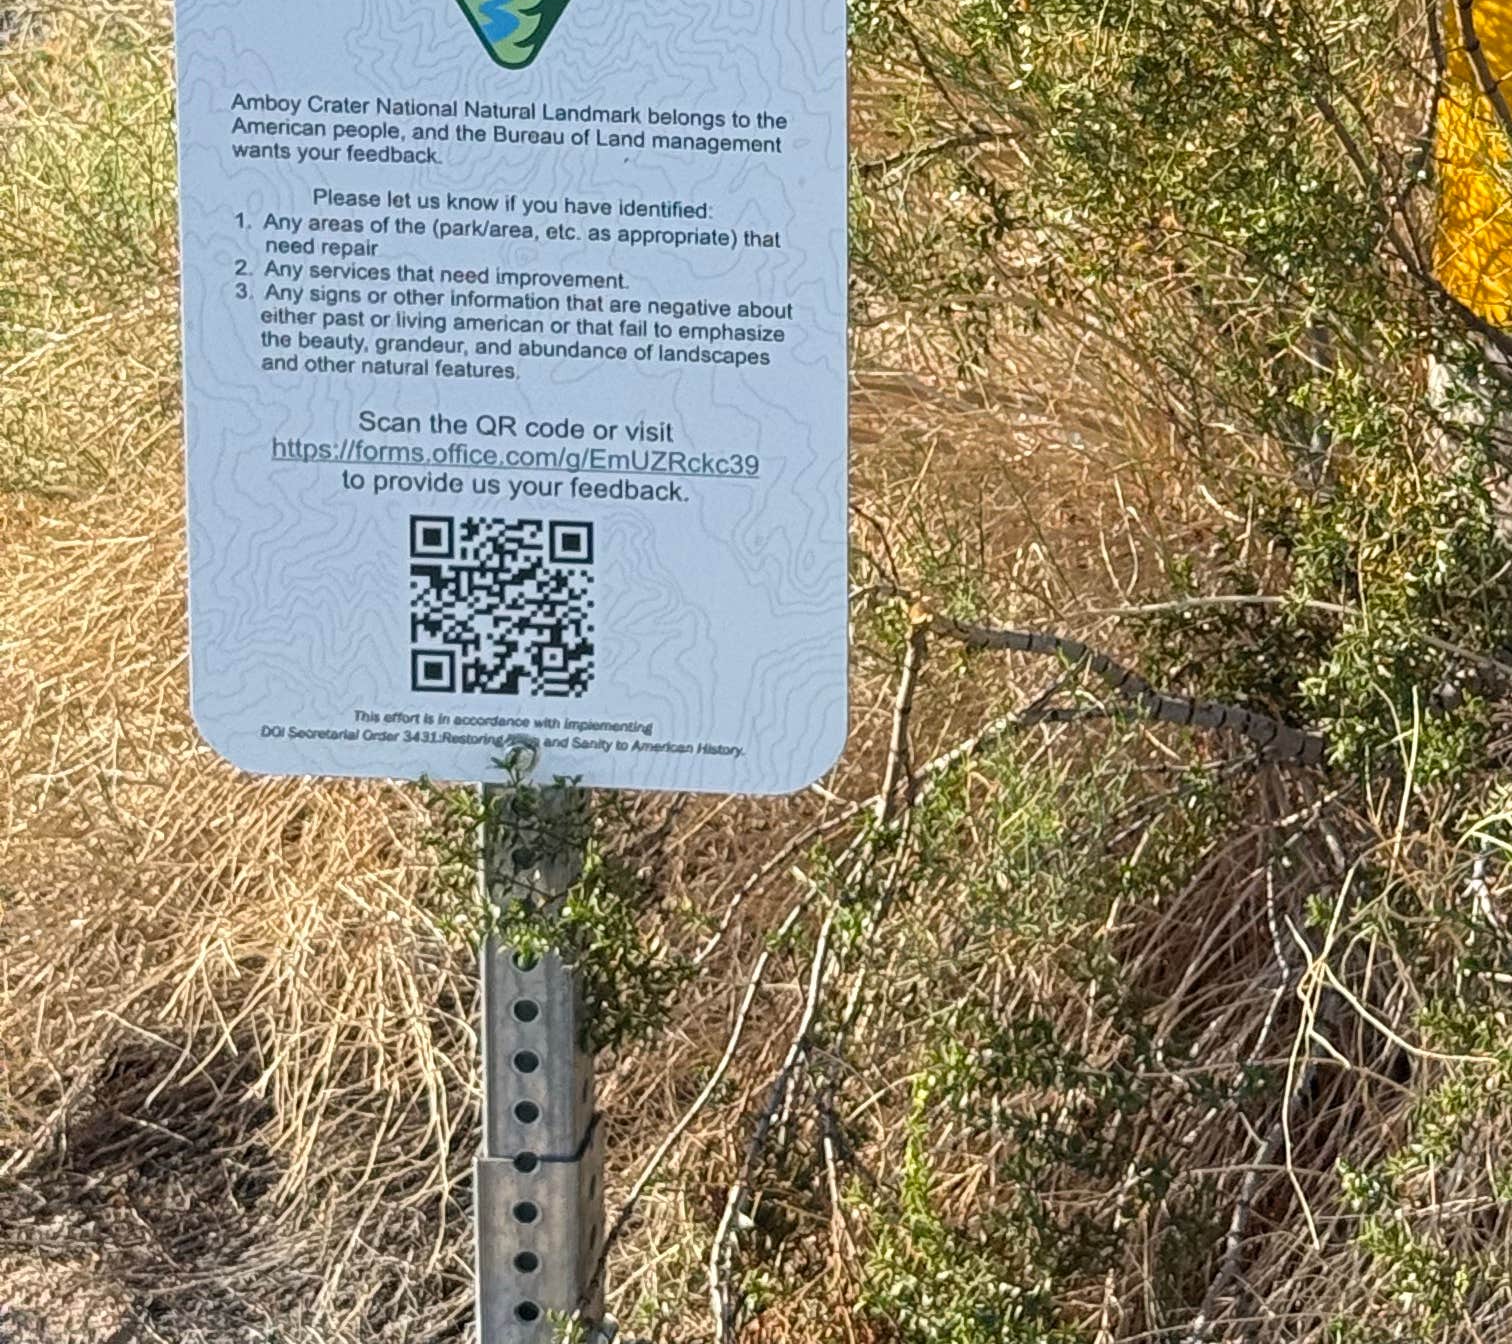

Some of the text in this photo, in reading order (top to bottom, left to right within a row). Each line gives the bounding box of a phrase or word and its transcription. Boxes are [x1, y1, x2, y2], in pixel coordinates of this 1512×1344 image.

[230, 92, 788, 132] Amboy Crater National Natural Landmark belongs to the
[231, 115, 782, 156] American people, and the Bureau of Land management
[231, 142, 443, 165] wants your feedback.
[234, 258, 630, 291] 2. Any services that need improvement.
[261, 353, 520, 381] and other natural features.
[358, 410, 674, 444] Scan the QR code or visit
[341, 468, 690, 503] to provide us your feedback.
[353, 709, 654, 738] This effort is in accordance with implementing
[544, 737, 568, 750] and
